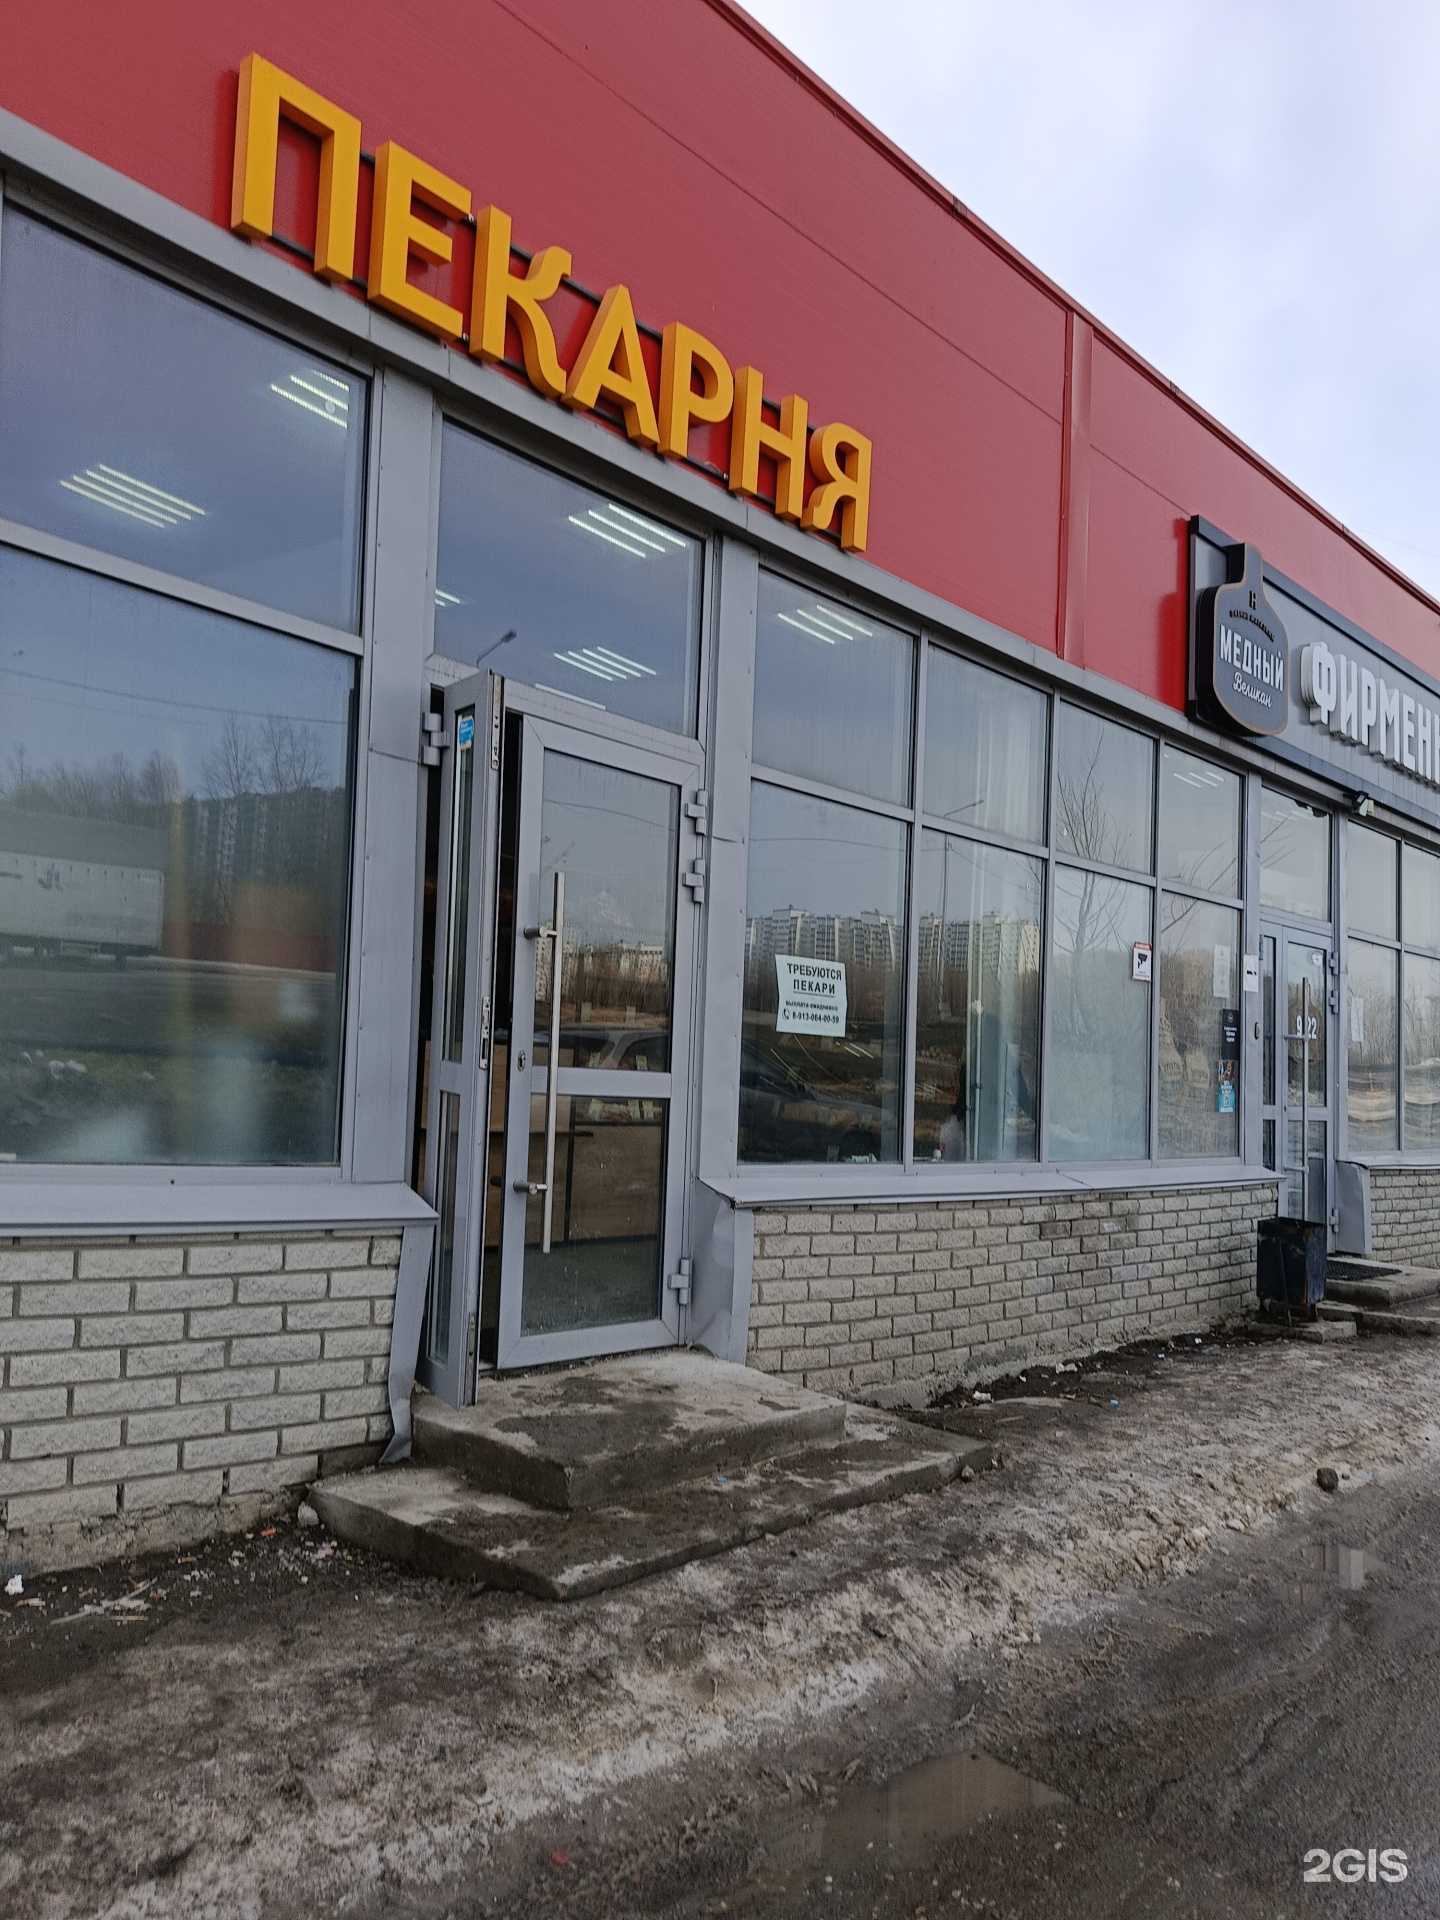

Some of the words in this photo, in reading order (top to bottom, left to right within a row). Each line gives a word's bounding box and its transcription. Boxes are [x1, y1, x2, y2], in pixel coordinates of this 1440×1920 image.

[231, 51, 872, 553] ПЕКАРНЯ
[1220, 624, 1283, 692] МЕДНЫЙ
[1232, 672, 1272, 709] Великан
[786, 963, 842, 981] ТРЕБУЮТСЯ
[793, 979, 835, 994] ПЕКАРИ
